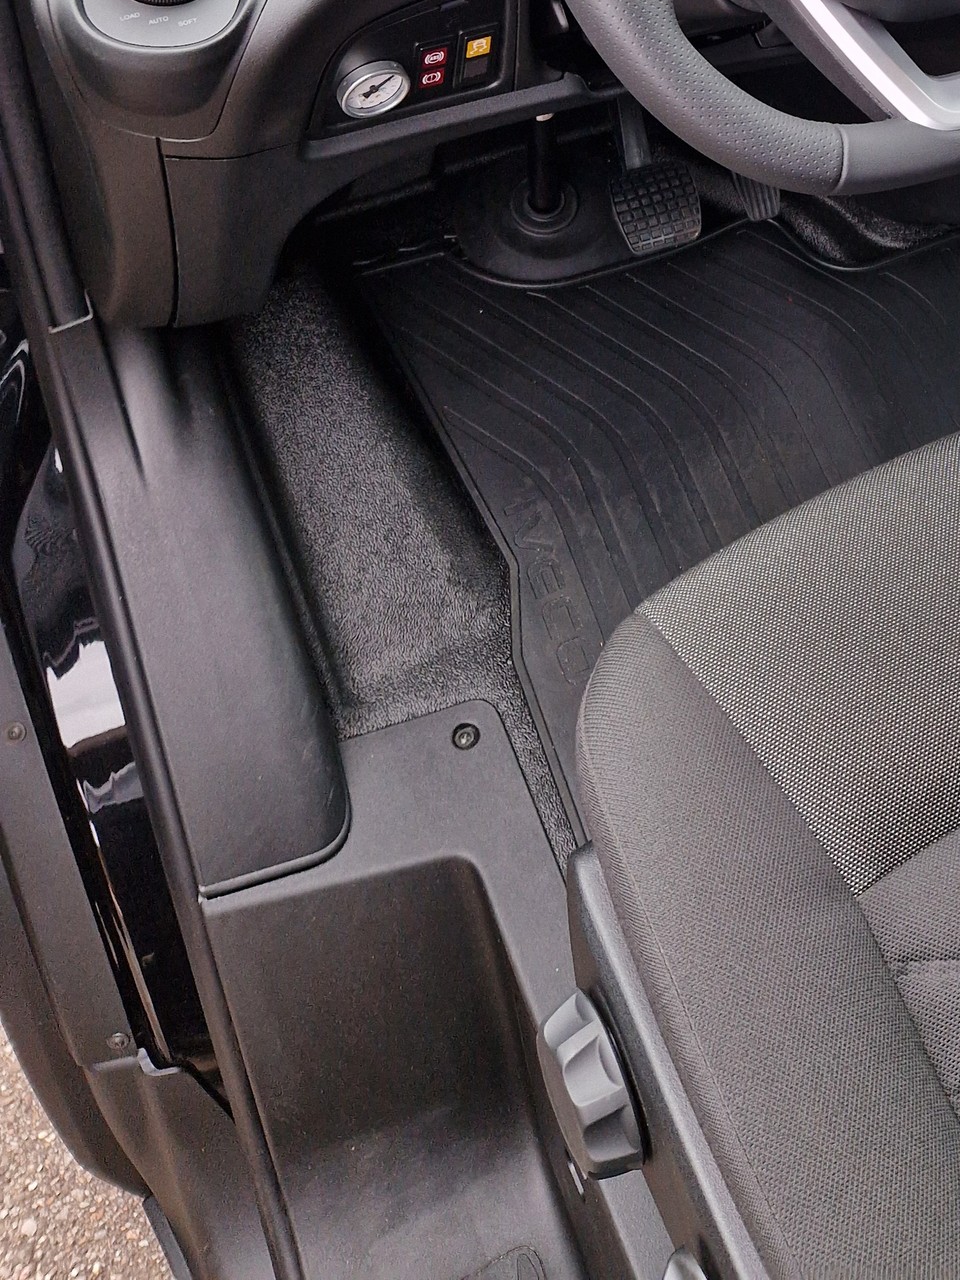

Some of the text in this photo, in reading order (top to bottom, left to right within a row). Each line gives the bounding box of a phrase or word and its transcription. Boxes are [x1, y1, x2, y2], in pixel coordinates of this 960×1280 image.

[120, 12, 140, 22] LOAD
[148, 16, 169, 25] AUTO
[178, 17, 198, 27] SOFT
